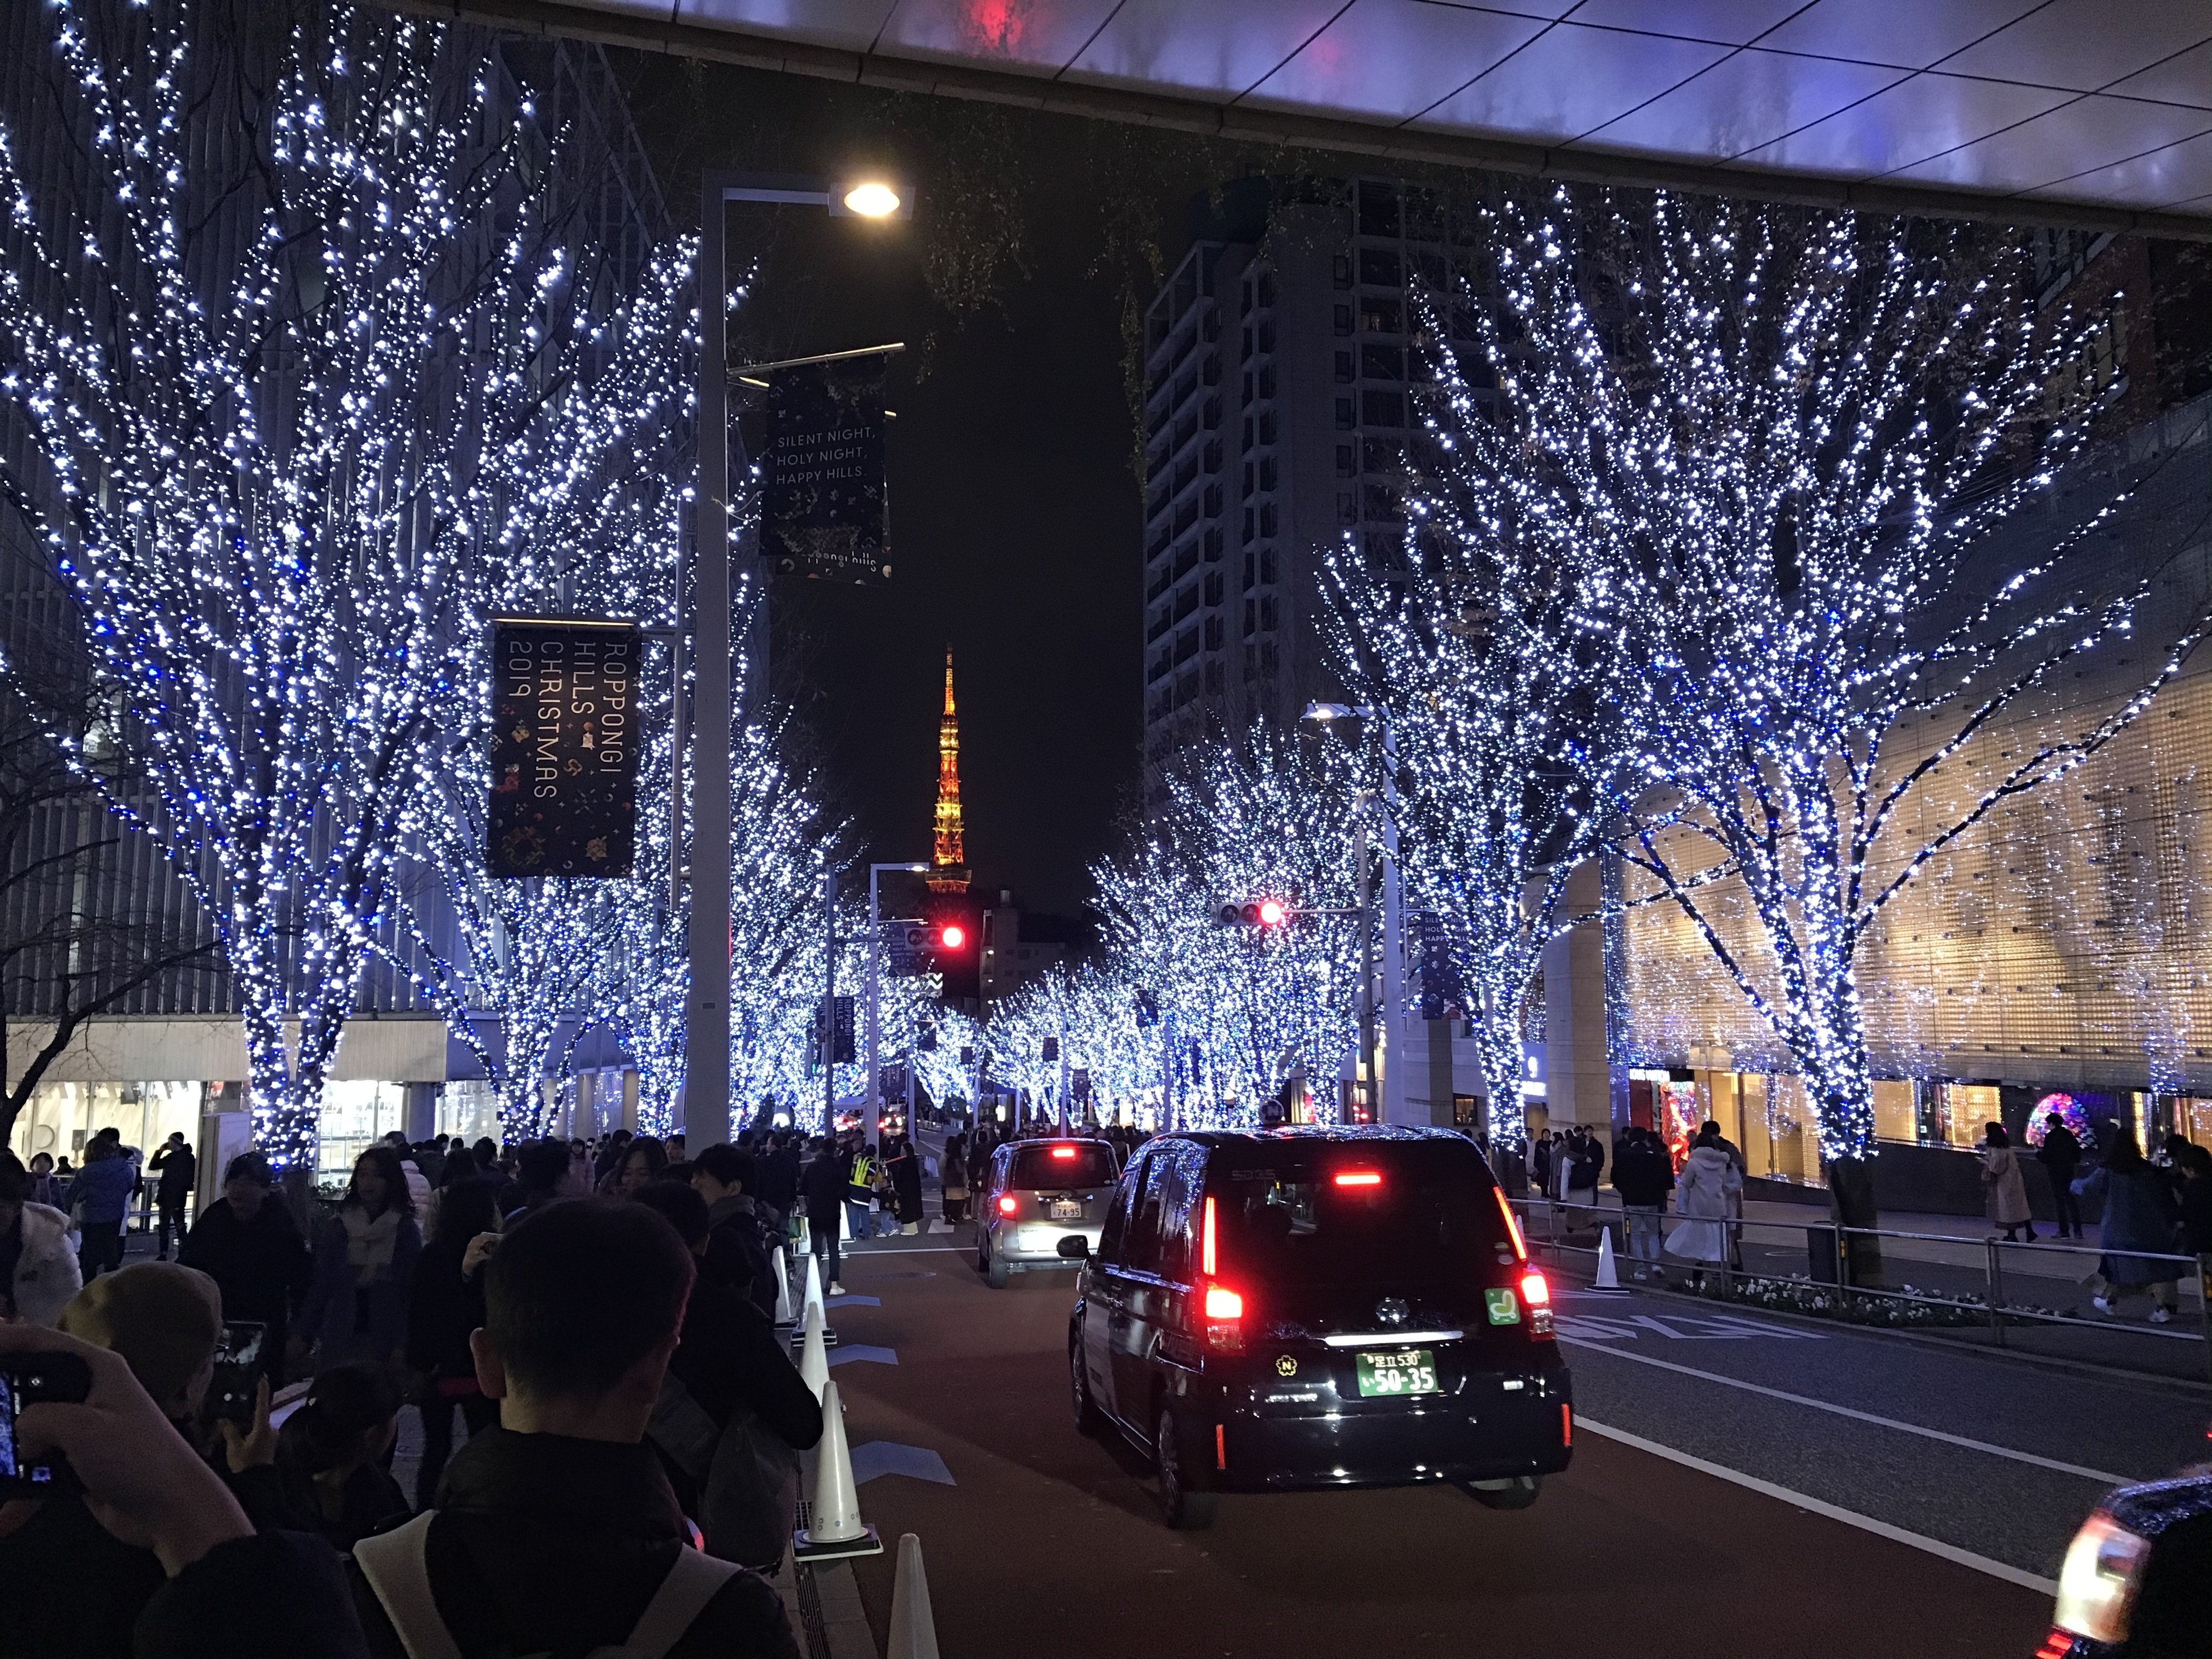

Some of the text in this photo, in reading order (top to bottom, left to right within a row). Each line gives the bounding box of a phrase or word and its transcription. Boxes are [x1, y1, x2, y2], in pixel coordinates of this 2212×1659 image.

[777, 427, 876, 448] SILENT NIGHT,
[777, 447, 868, 466] HOLY NIGHT,
[776, 466, 867, 485] HAPPY HILLS.
[508, 641, 533, 697] 2019
[571, 642, 596, 714] HILLS
[533, 641, 564, 798] CHRISTMAS
[600, 642, 628, 772] ROPPONGI
[1057, 1208, 1080, 1216] 74-95
[1374, 1367, 1434, 1392] 50-35
